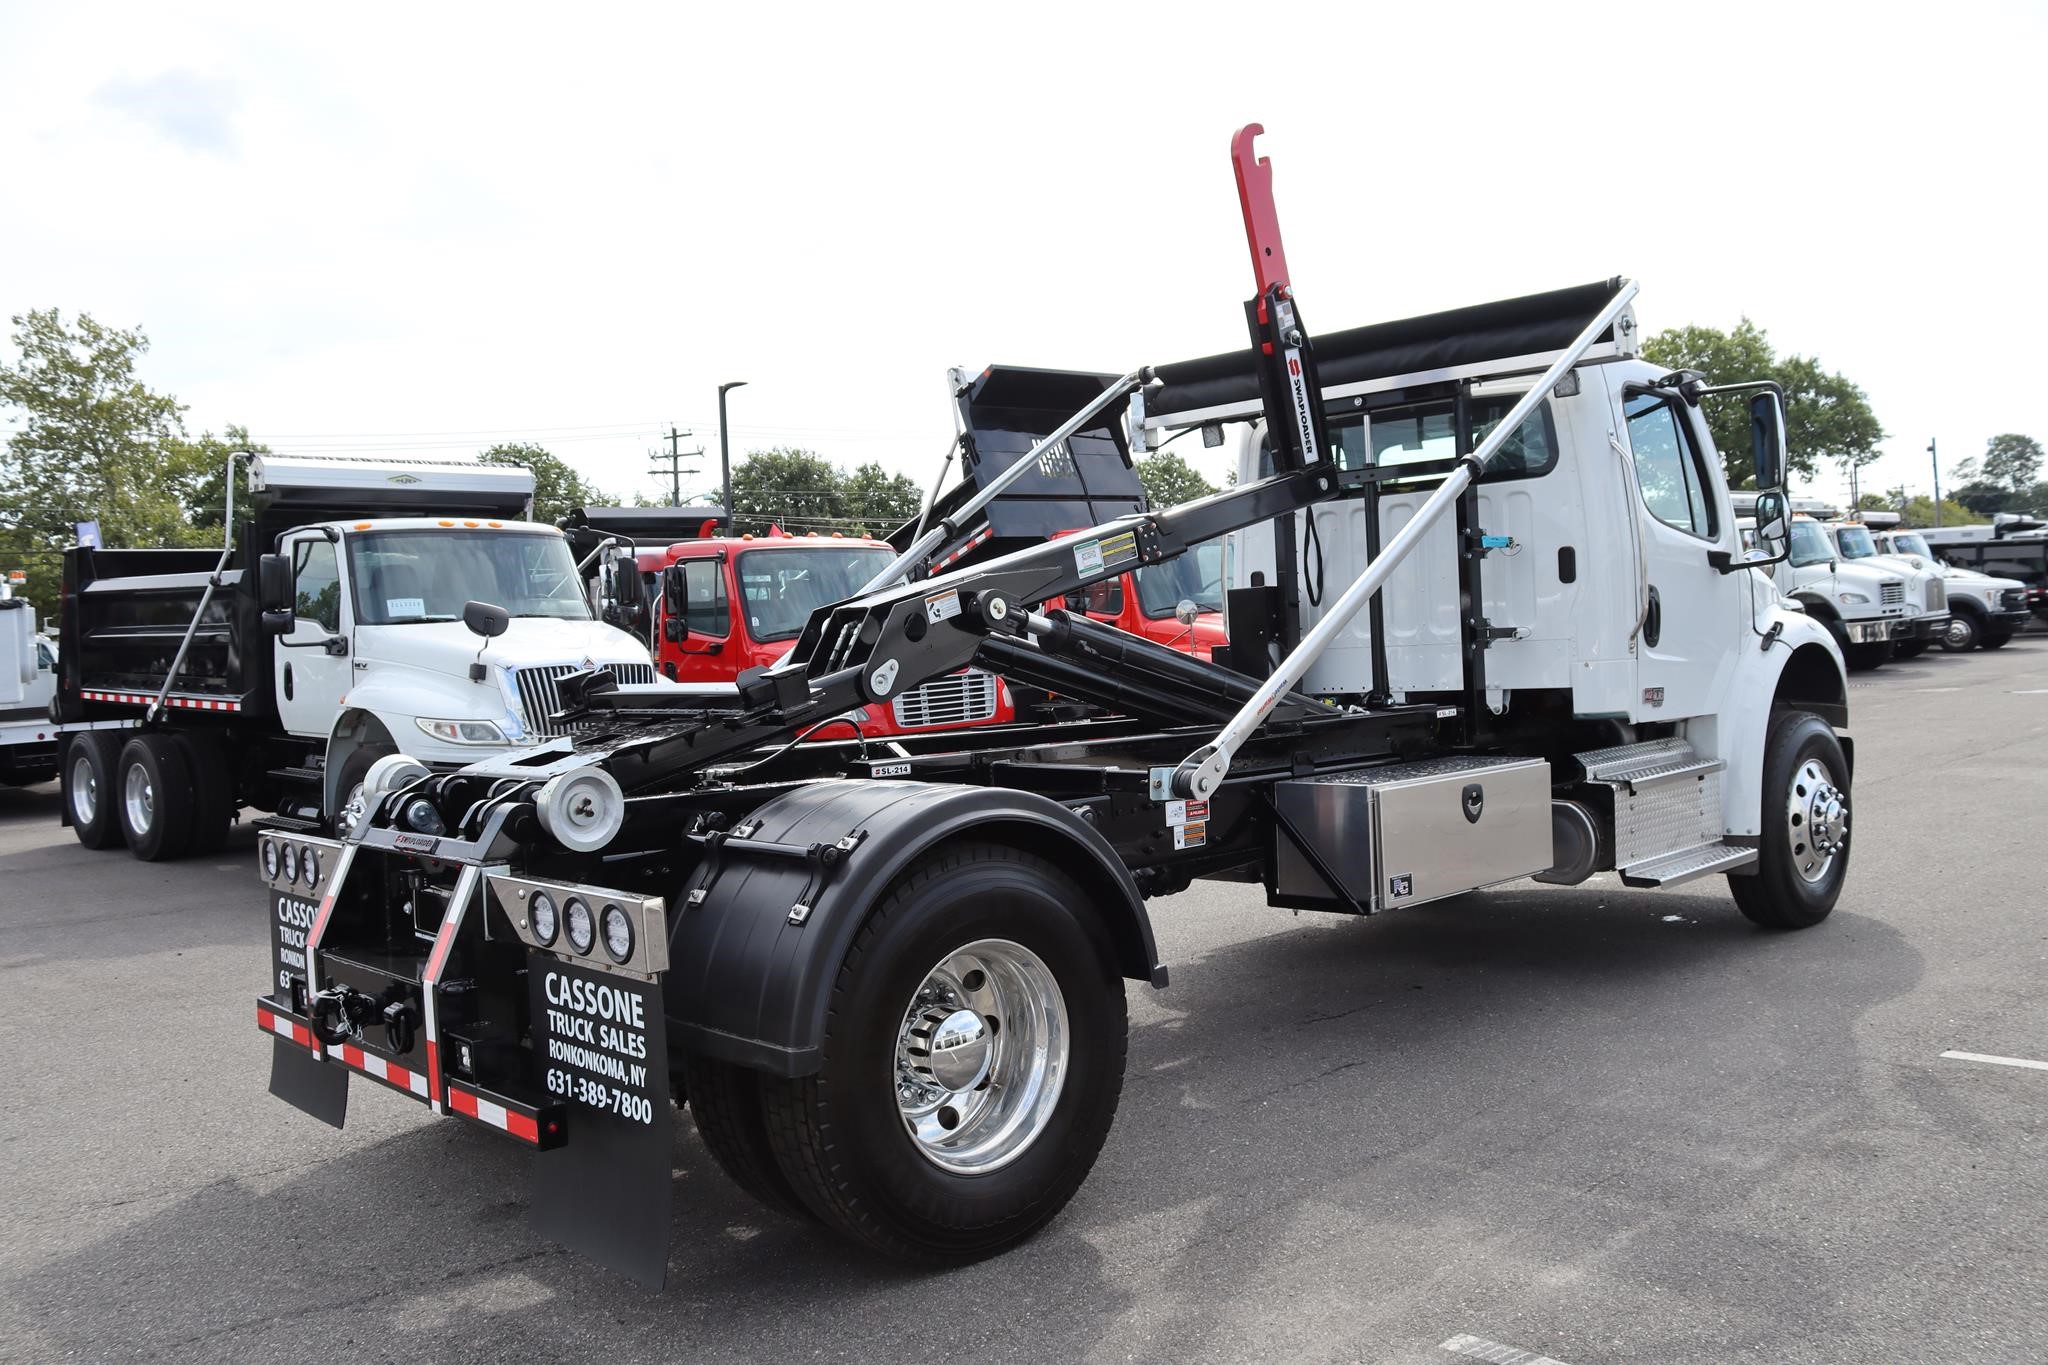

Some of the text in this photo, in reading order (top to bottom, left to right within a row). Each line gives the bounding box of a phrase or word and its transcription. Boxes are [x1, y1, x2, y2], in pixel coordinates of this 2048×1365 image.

[1294, 379, 1312, 454] SWAPLOADER
[881, 766, 908, 774] SL-214
[278, 897, 319, 930] CASSO
[279, 925, 305, 949] TRUCK
[280, 947, 305, 970] RONKON
[545, 972, 645, 1029] CASSONE
[547, 1008, 647, 1060] TRUCK SALES
[549, 1038, 647, 1088] RONKONKOMA, NY
[547, 1068, 652, 1125] 631-389-7800
